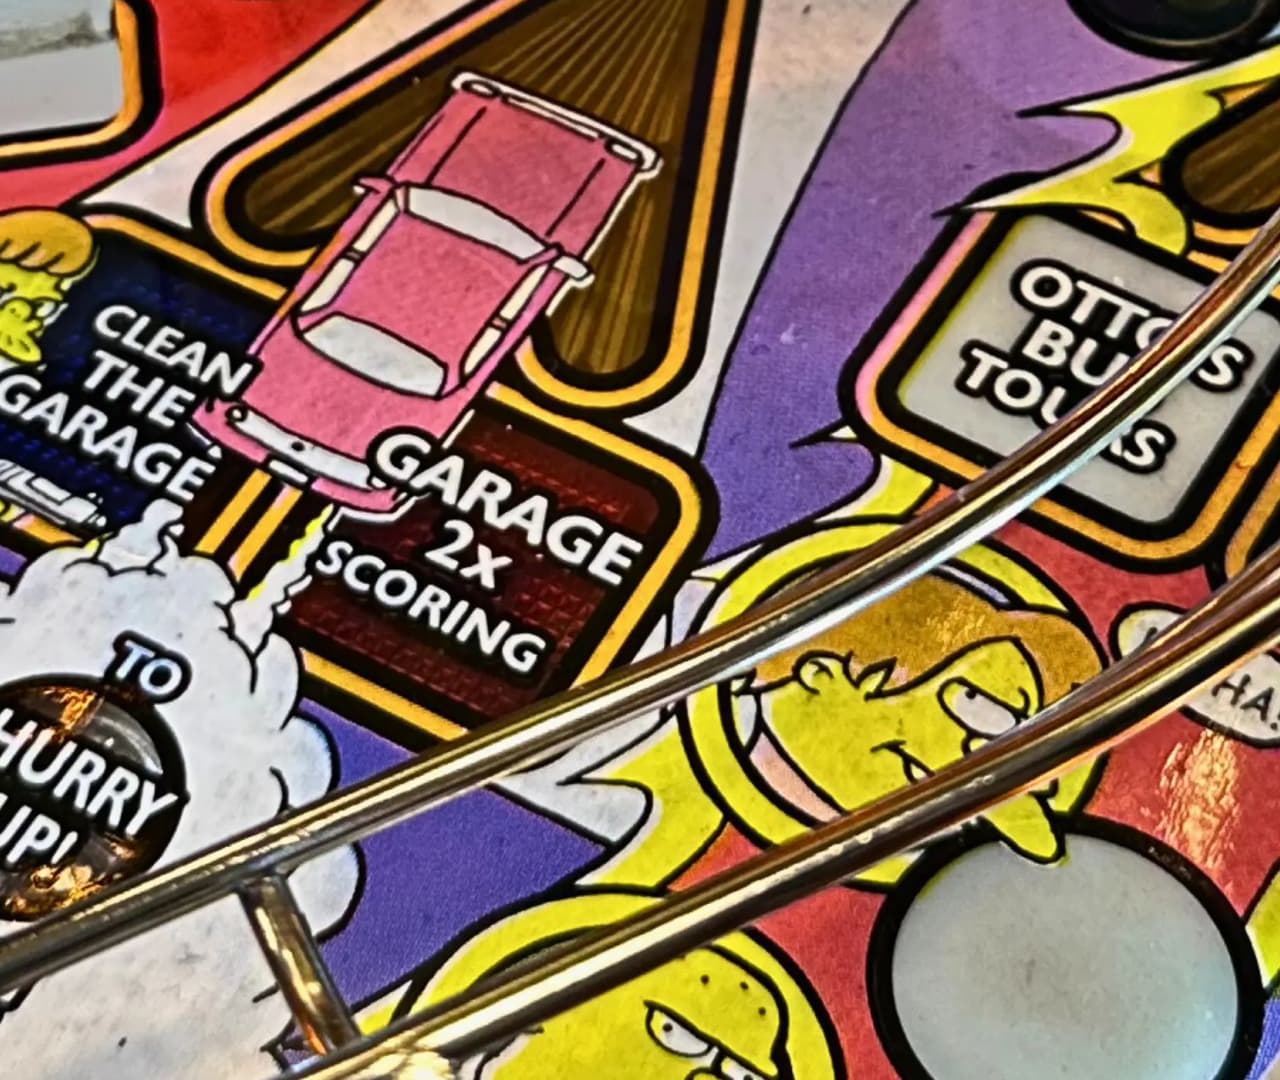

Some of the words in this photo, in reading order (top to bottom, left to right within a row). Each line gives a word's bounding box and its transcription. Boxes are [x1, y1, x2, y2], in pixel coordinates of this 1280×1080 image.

[83, 350, 195, 428] THE
[94, 304, 253, 394] CLEAN
[1022, 319, 1130, 387] BU
[968, 347, 1166, 467] TOS
[375, 433, 643, 587] GARAGE
[424, 519, 512, 590] 2x
[316, 540, 546, 674] SCORING
[116, 642, 182, 696] TO
